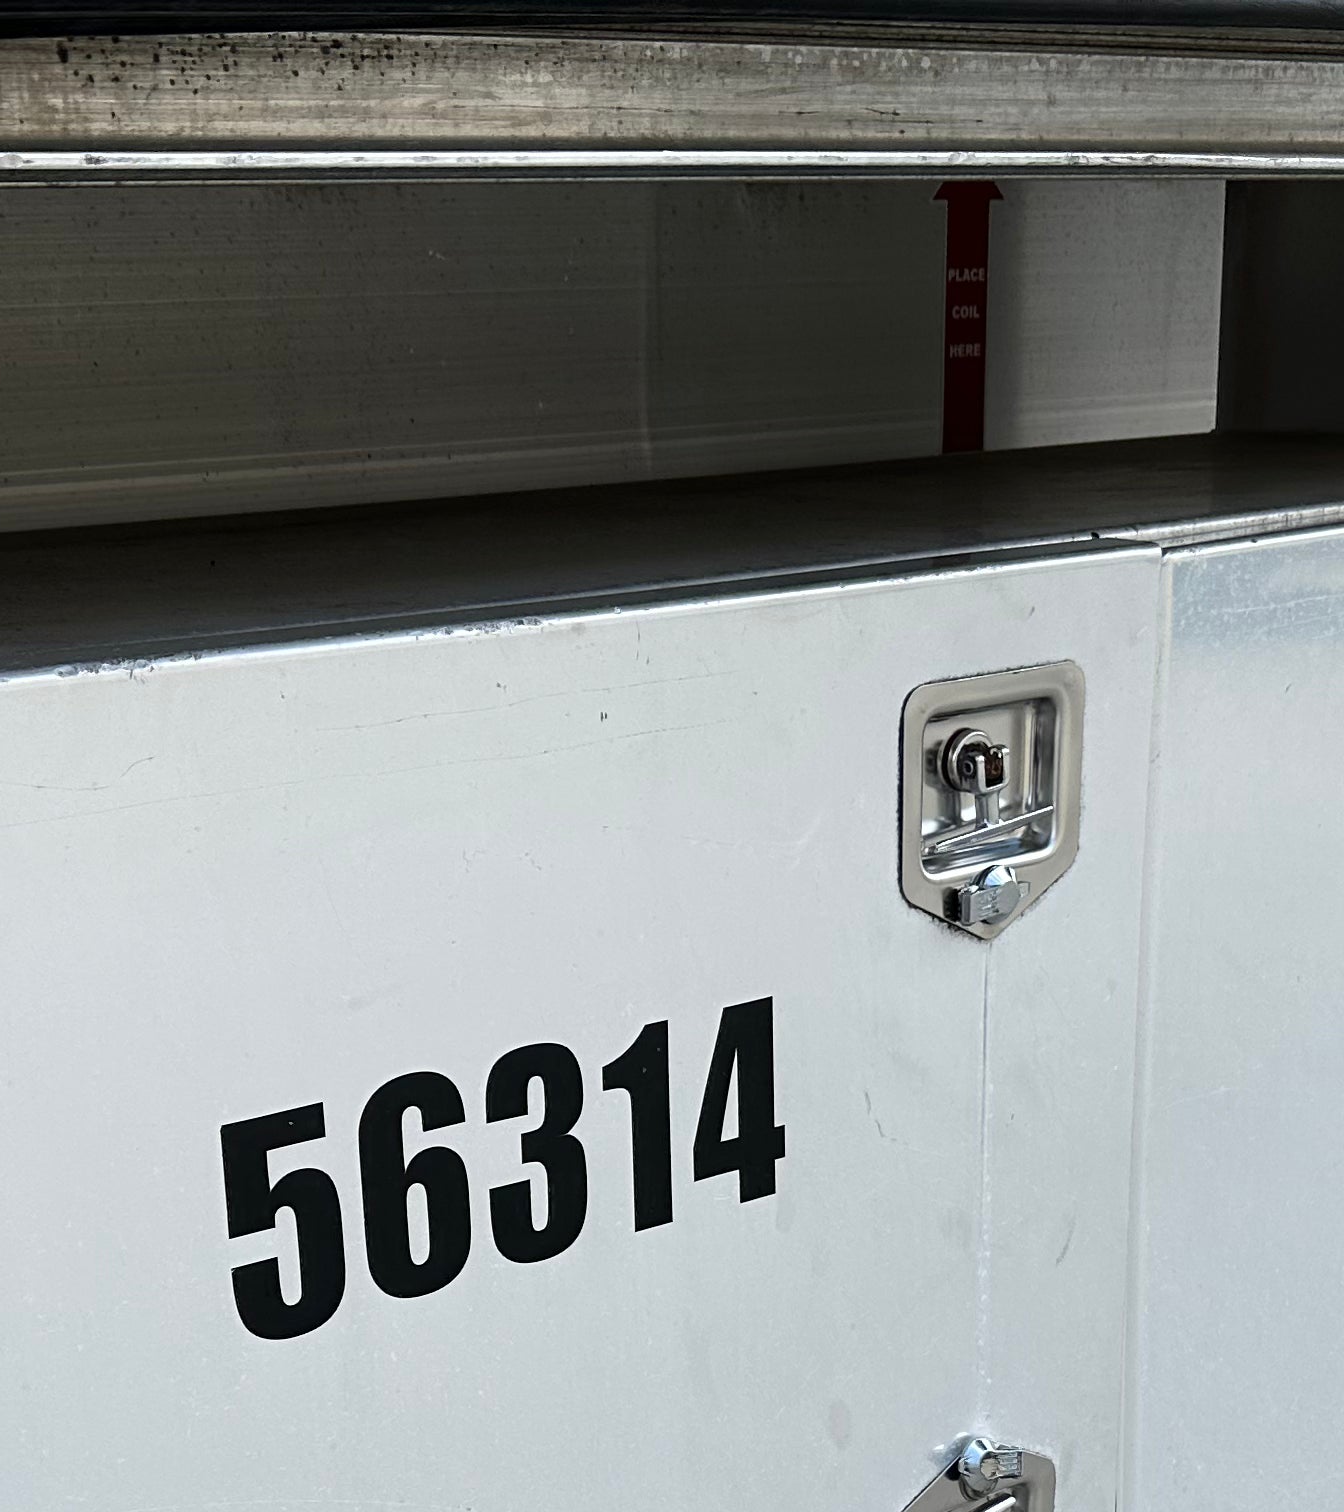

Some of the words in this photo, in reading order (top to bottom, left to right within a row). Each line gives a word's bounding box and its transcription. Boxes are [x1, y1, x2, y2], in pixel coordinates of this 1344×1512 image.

[948, 267, 985, 282] PLACE
[952, 304, 980, 320] COIL
[949, 343, 981, 358] HERE
[220, 995, 786, 1341] 56314
